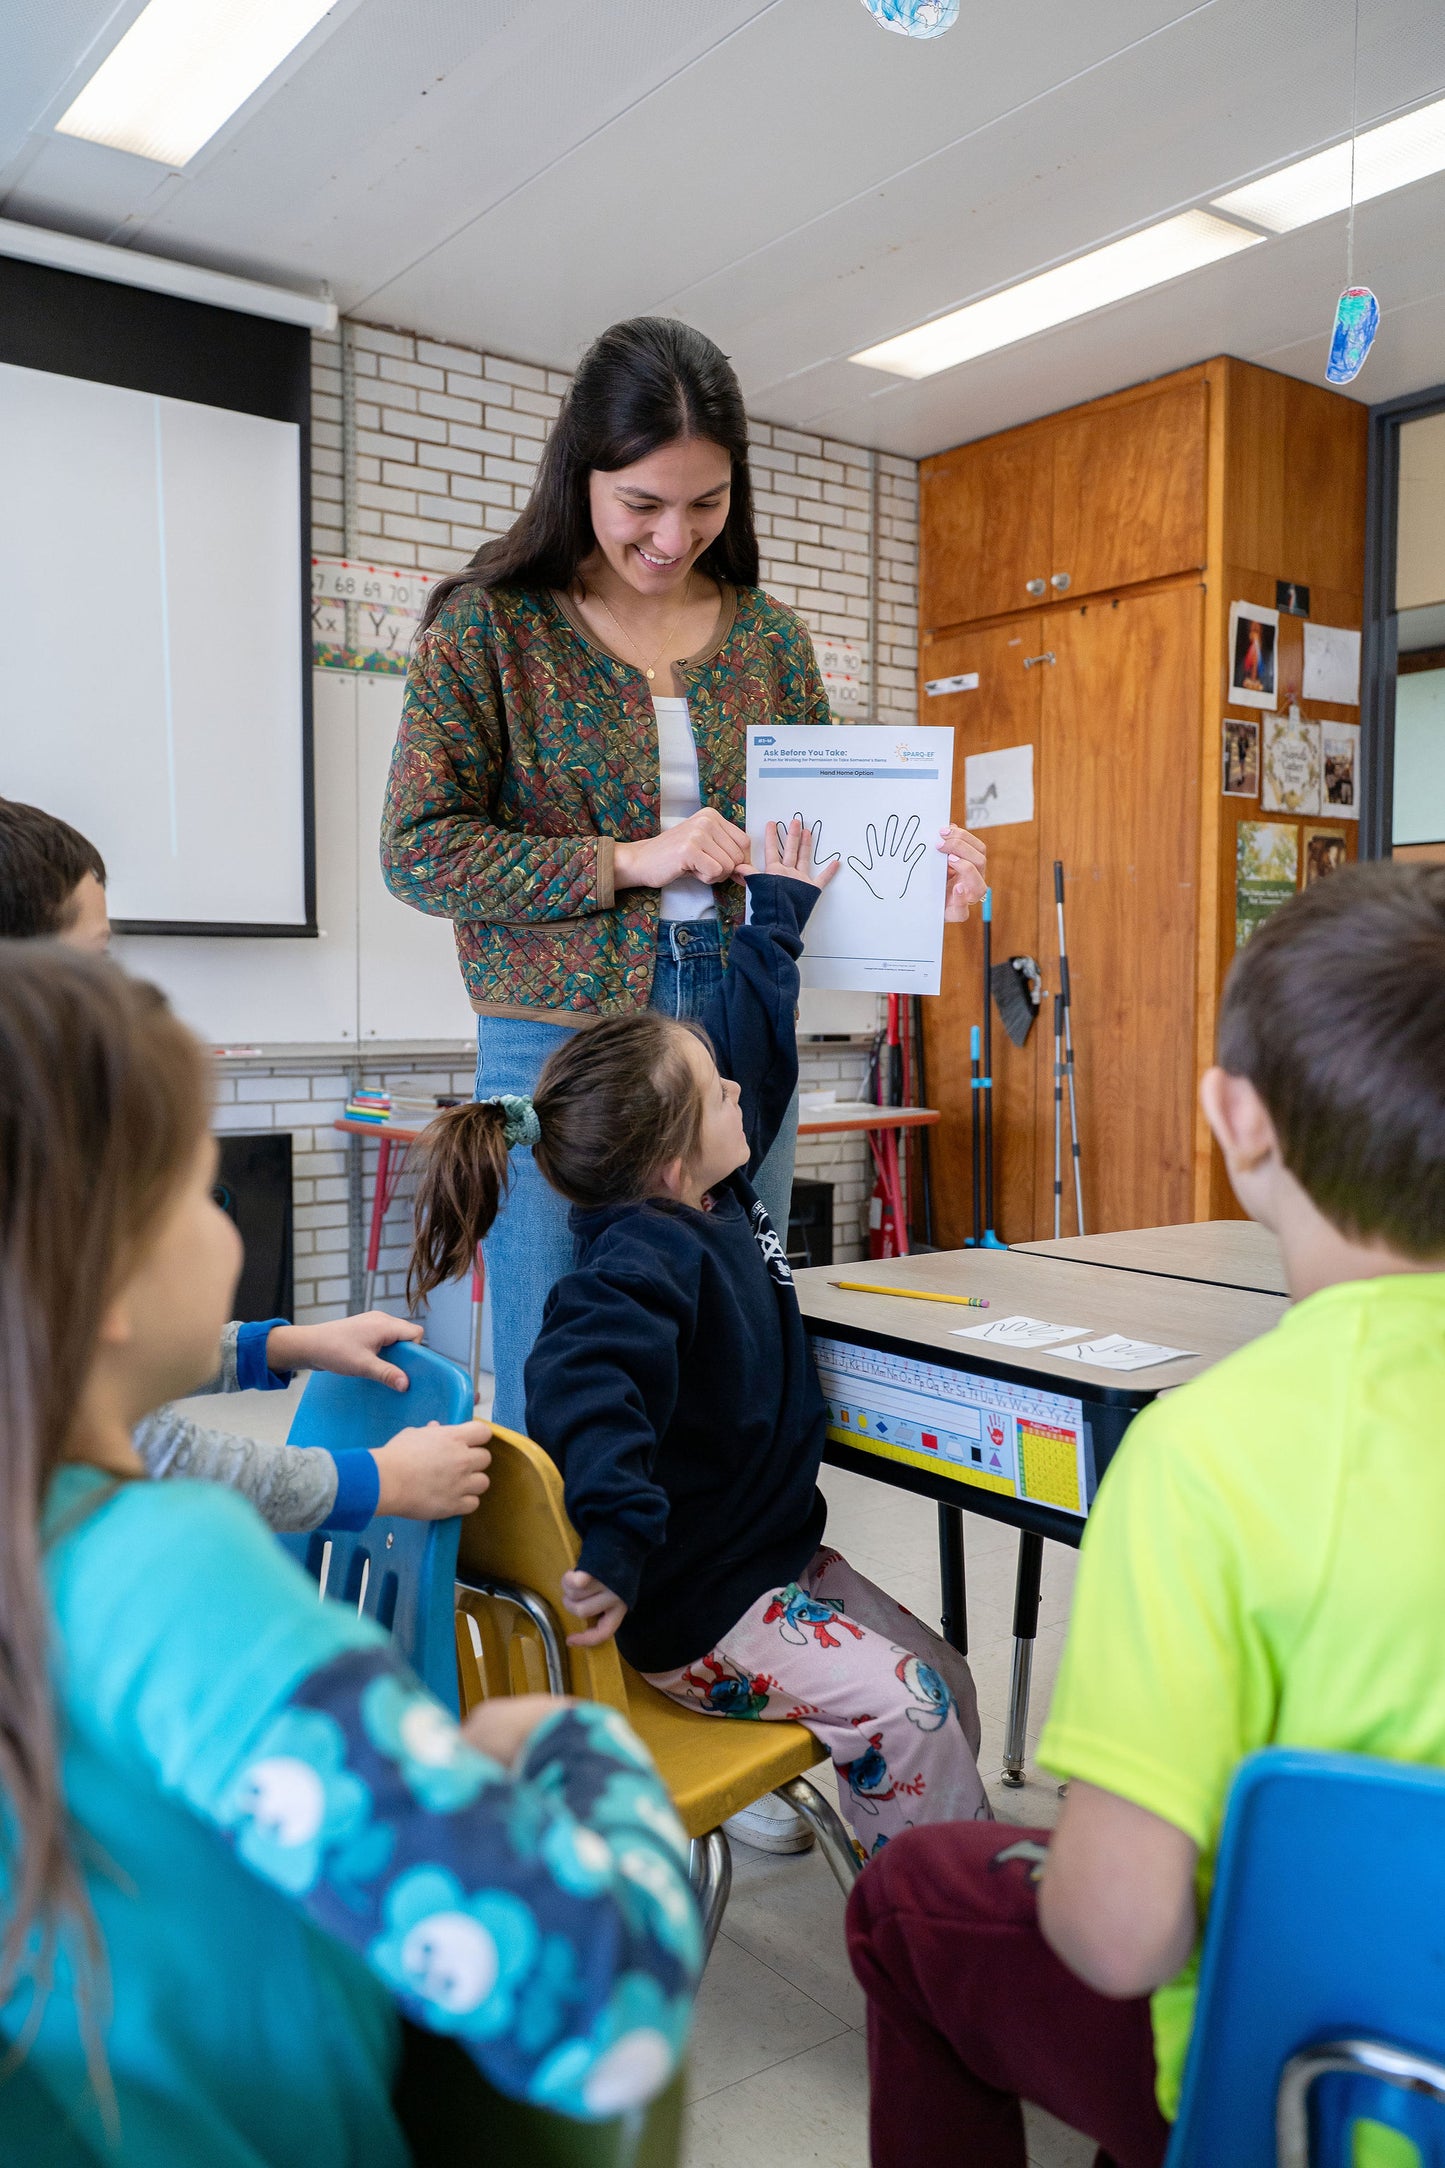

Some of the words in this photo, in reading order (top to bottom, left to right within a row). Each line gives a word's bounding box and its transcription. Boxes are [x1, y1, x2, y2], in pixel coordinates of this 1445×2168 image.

[335, 577, 356, 594] 68
[363, 581, 382, 598] 69
[389, 585, 410, 603] 70
[824, 652, 838, 667] 89
[843, 655, 860, 670] 90
[840, 686, 859, 701] 100
[900, 1371, 912, 1384] Oo
[915, 1374, 924, 1391] Pp
[926, 1378, 941, 1396] Qq
[1064, 1410, 1077, 1424] Zz
[1048, 1425, 1062, 1433] Chart
